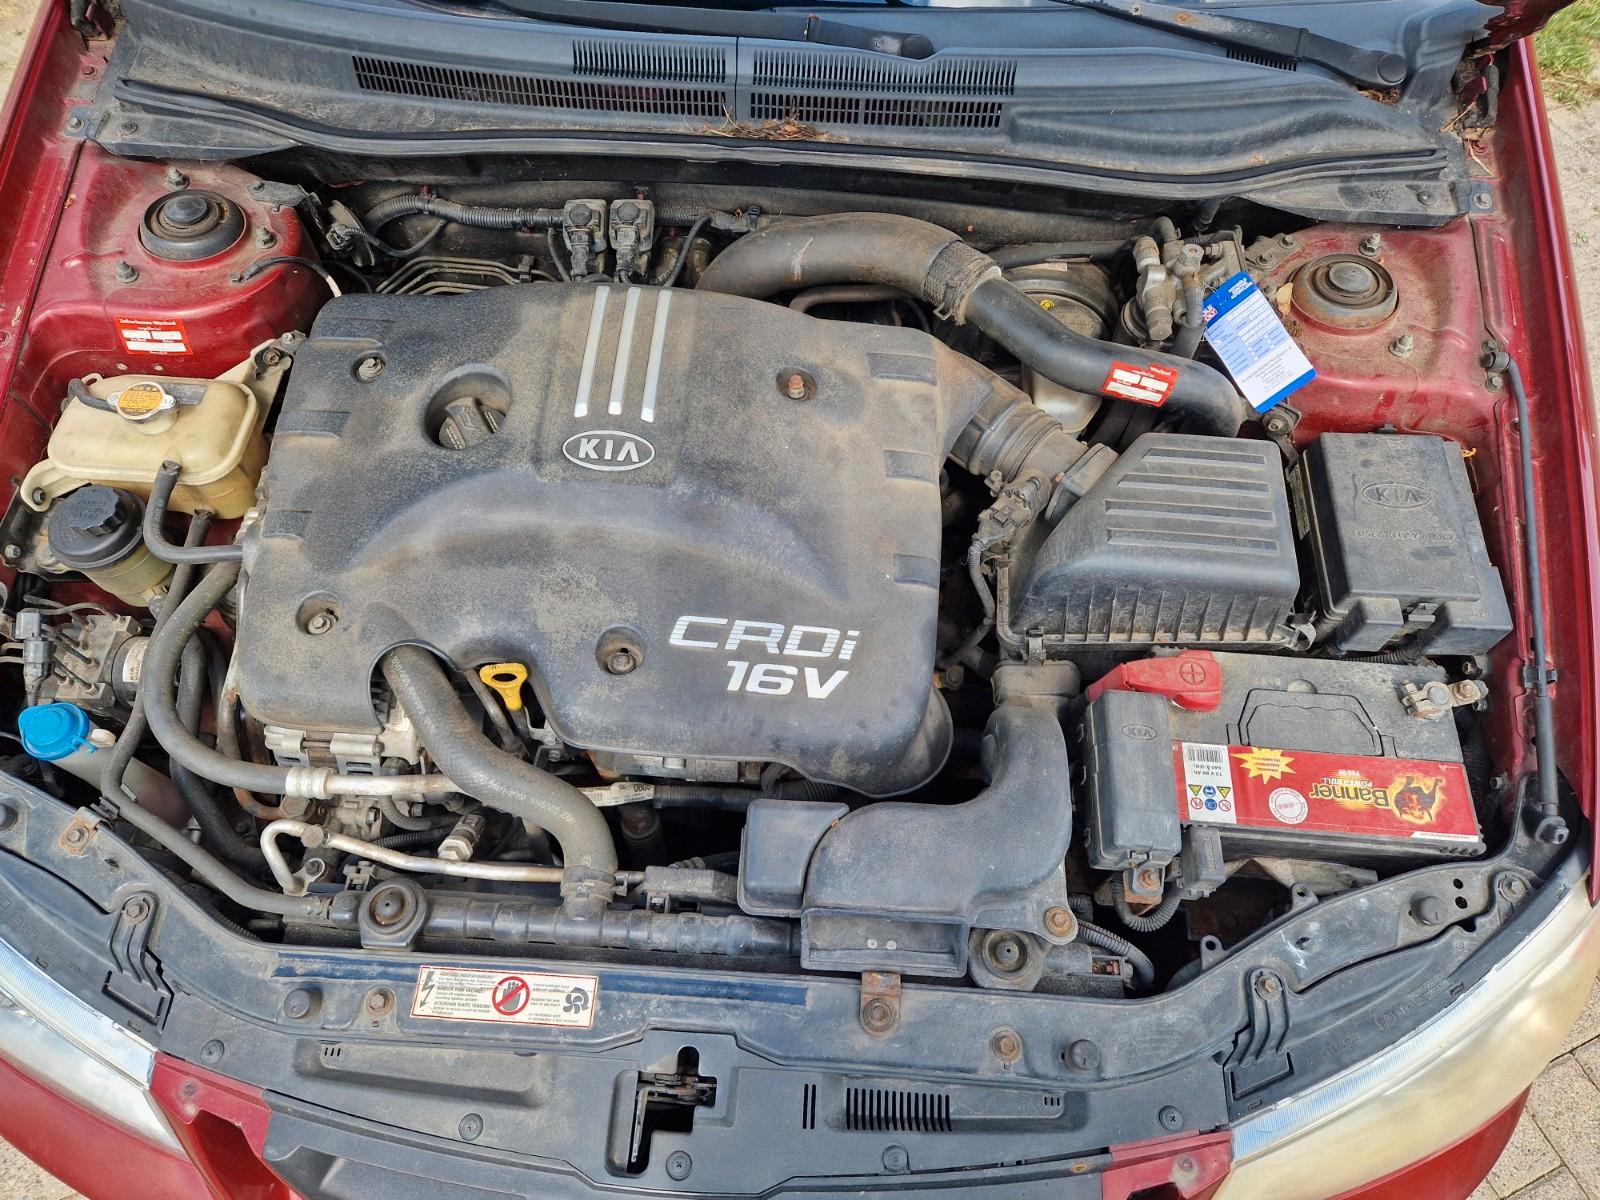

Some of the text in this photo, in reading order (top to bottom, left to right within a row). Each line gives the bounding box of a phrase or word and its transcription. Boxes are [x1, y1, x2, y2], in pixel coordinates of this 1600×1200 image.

[577, 437, 640, 463] KIA
[1375, 489, 1421, 502] KIA
[670, 615, 860, 661] CRDi
[1321, 776, 1373, 788] POWER BULL
[1309, 783, 1391, 809] Banner
